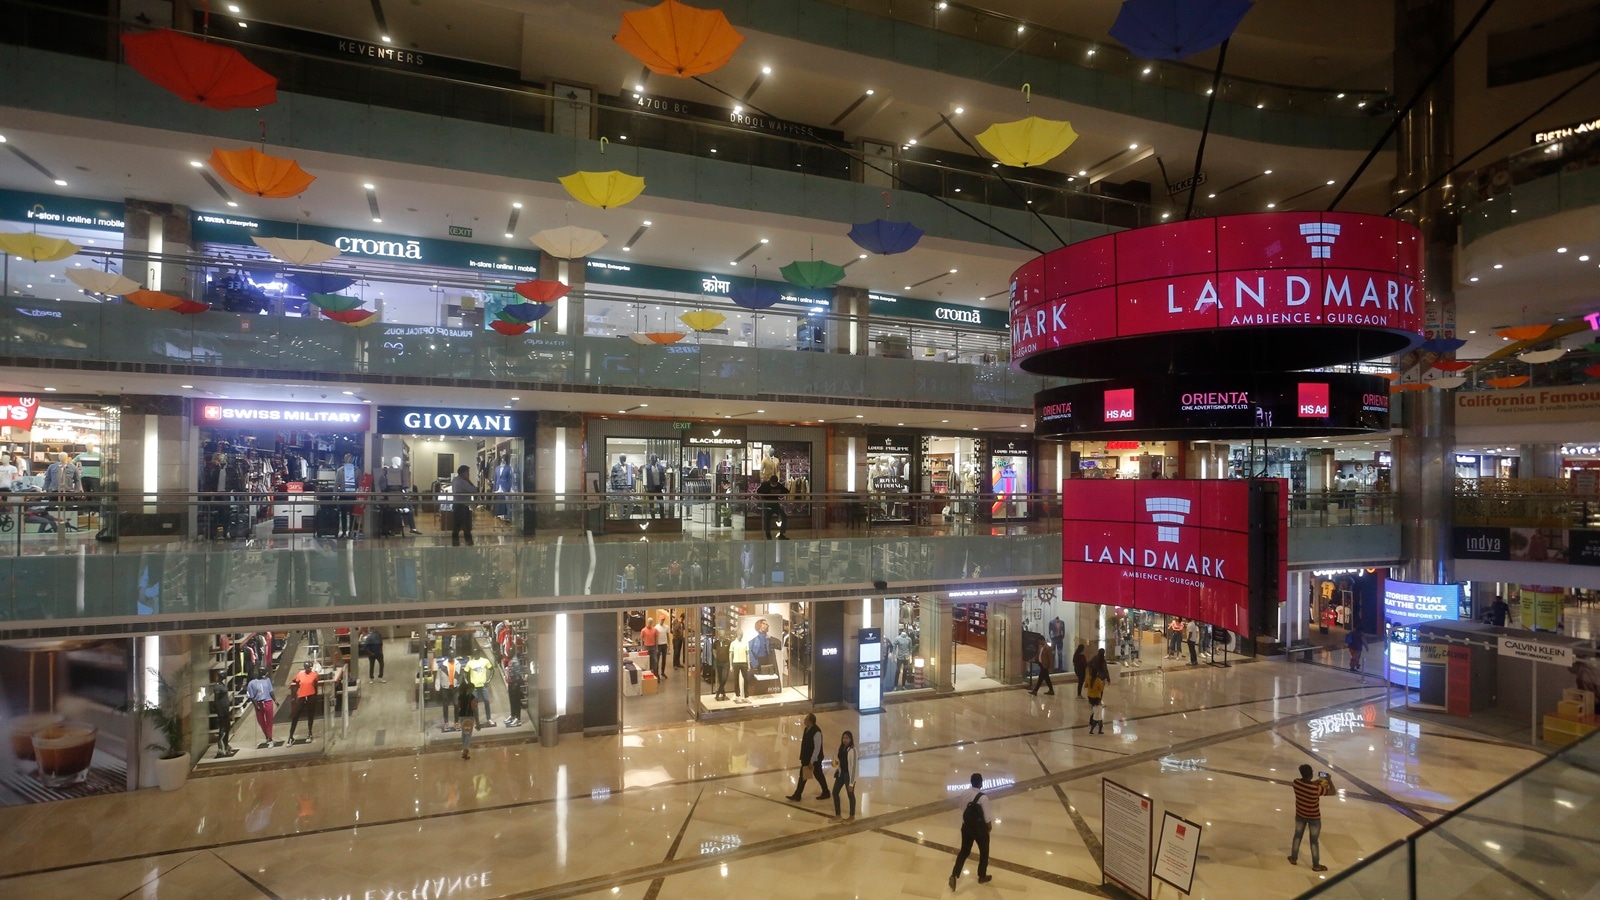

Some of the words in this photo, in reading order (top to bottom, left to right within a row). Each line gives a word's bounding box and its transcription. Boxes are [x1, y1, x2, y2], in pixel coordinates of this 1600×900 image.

[339, 40, 424, 66] KEVENTERS
[637, 97, 668, 110] 4700
[674, 103, 688, 113] BC
[730, 113, 765, 128] DROOL
[768, 120, 814, 136] WAFFLES
[1535, 127, 1573, 143] FIFTH
[66, 216, 93, 226] online
[98, 219, 125, 228] mobile
[226, 219, 258, 228] Enterprise
[452, 226, 472, 236] EXIT
[496, 263, 514, 271] online
[517, 265, 537, 273] mobile
[702, 276, 730, 294] क्रोमा
[1168, 274, 1414, 314] LANDMARK
[1231, 312, 1311, 325] AMBIENCE
[1327, 312, 1387, 326] GURGAON
[1181, 391, 1248, 405] ORIENTA
[1458, 393, 1536, 408] California
[222, 408, 281, 420] SWISS
[284, 410, 361, 423] MILITARY
[1043, 402, 1072, 417] ORIENTA
[1106, 410, 1119, 419] HS
[1120, 409, 1132, 418] Ad
[1300, 405, 1314, 414] HS
[1315, 405, 1327, 414] Ad
[404, 412, 511, 431] GIOVANI
[689, 437, 742, 445] BLACKBERRYS
[1466, 534, 1501, 551] indya
[1084, 545, 1226, 579] LANDMARK
[1122, 570, 1163, 582] AMBIENCE
[1169, 576, 1205, 588] GURGAON
[1385, 591, 1416, 602] STORIES
[1416, 595, 1443, 604] THAT
[1396, 601, 1414, 609] THE
[1415, 603, 1447, 611] CLOCK
[1407, 611, 1433, 619] BEFORE
[1504, 640, 1537, 653] CALVIN
[1538, 644, 1565, 657] KLEIN
[1515, 651, 1553, 661] PERFORMANCE
